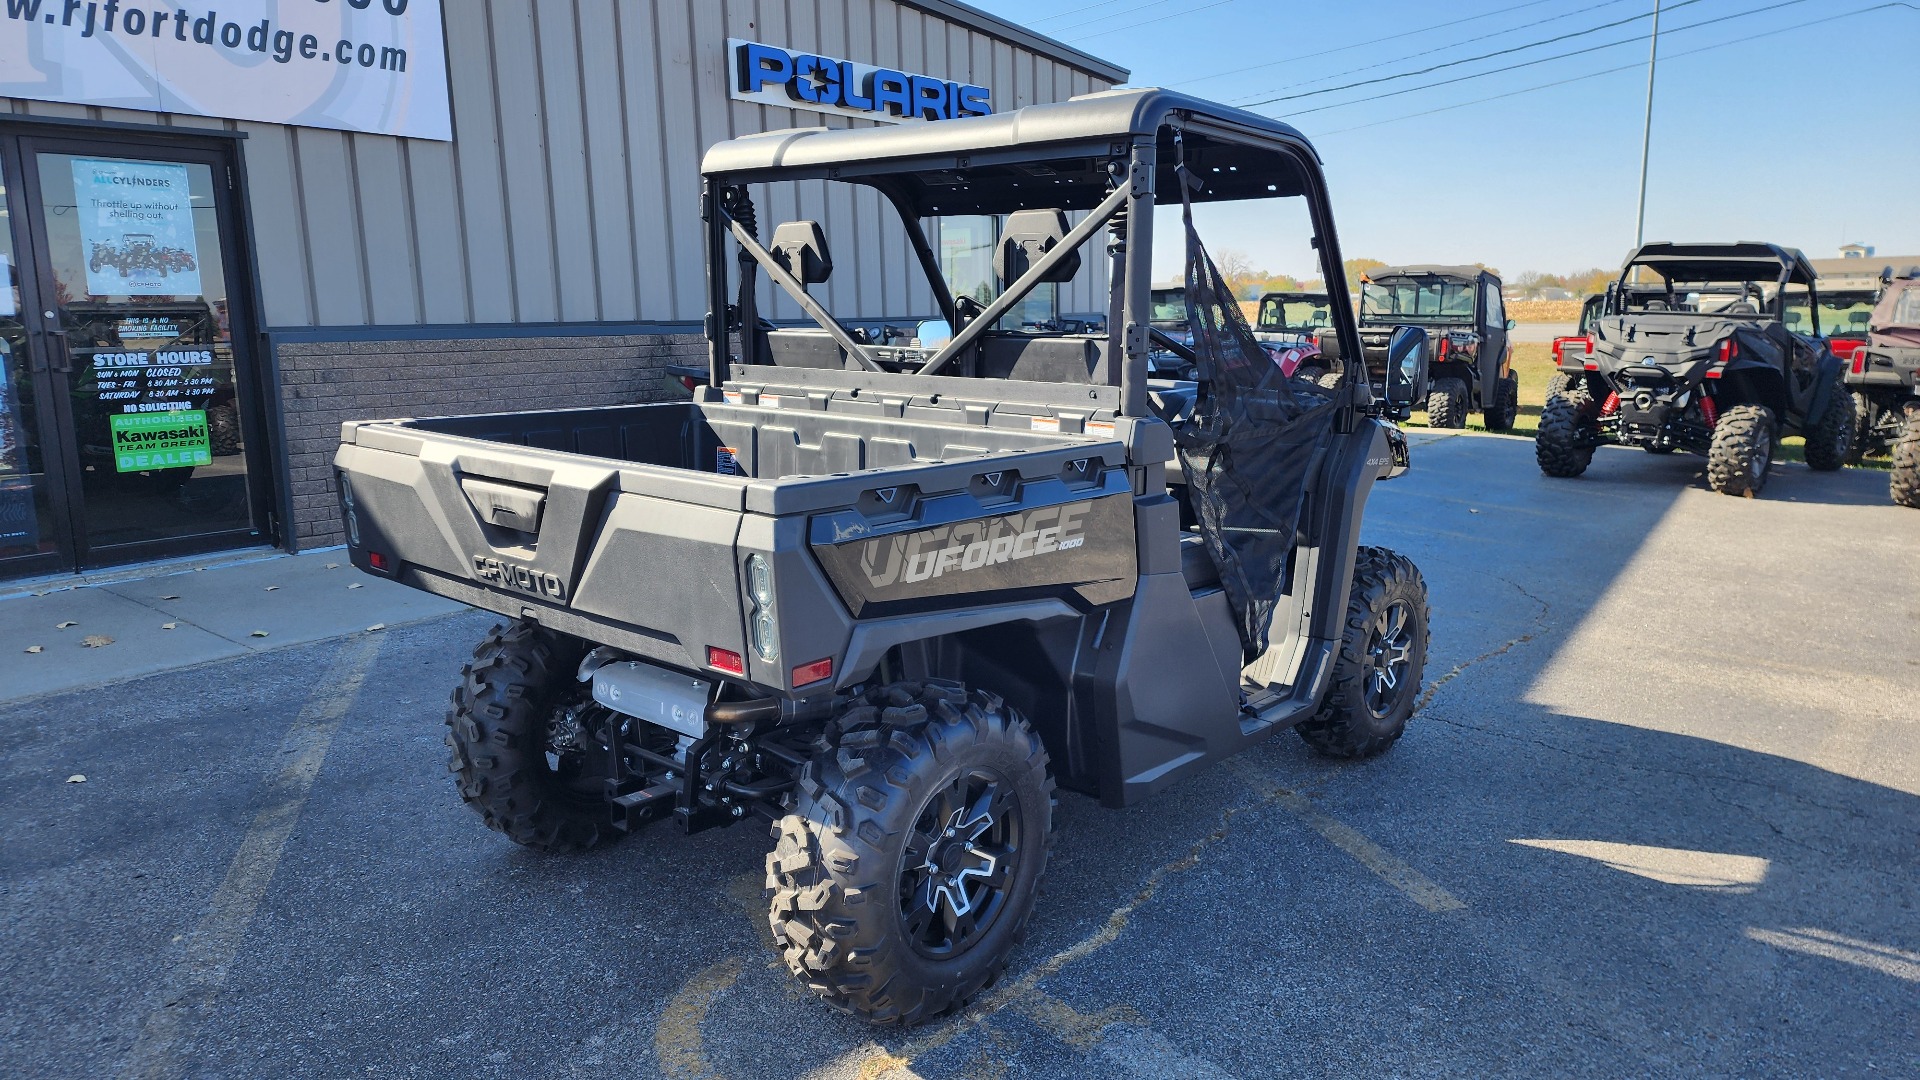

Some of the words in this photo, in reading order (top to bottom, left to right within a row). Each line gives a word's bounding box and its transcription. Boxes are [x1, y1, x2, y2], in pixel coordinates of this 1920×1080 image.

[738, 43, 993, 121] POLARIS
[91, 198, 128, 209] Throttle
[130, 203, 142, 211] up
[144, 201, 179, 211] without
[109, 209, 144, 220] shelling
[93, 353, 149, 367] STORE
[156, 351, 212, 364] HOURS
[120, 370, 139, 378] MON
[146, 367, 182, 378] CLOSED
[97, 381, 116, 389] TUES
[123, 380, 136, 388] FRI
[164, 379, 177, 387] AM
[200, 377, 213, 385] PM
[98, 390, 140, 400] SATURDAY
[165, 389, 179, 397] AM
[123, 404, 137, 413] NO
[138, 401, 192, 412] SOLICITING
[115, 414, 203, 426] AUTHORIZED
[116, 425, 205, 443] Kawasaki
[118, 443, 156, 451] TEAM
[160, 439, 205, 448] GREEN
[119, 450, 208, 468] DEALER
[906, 526, 1061, 583] UFORCE
[1059, 537, 1084, 550] 1000
[472, 554, 562, 597] CFMOTO
